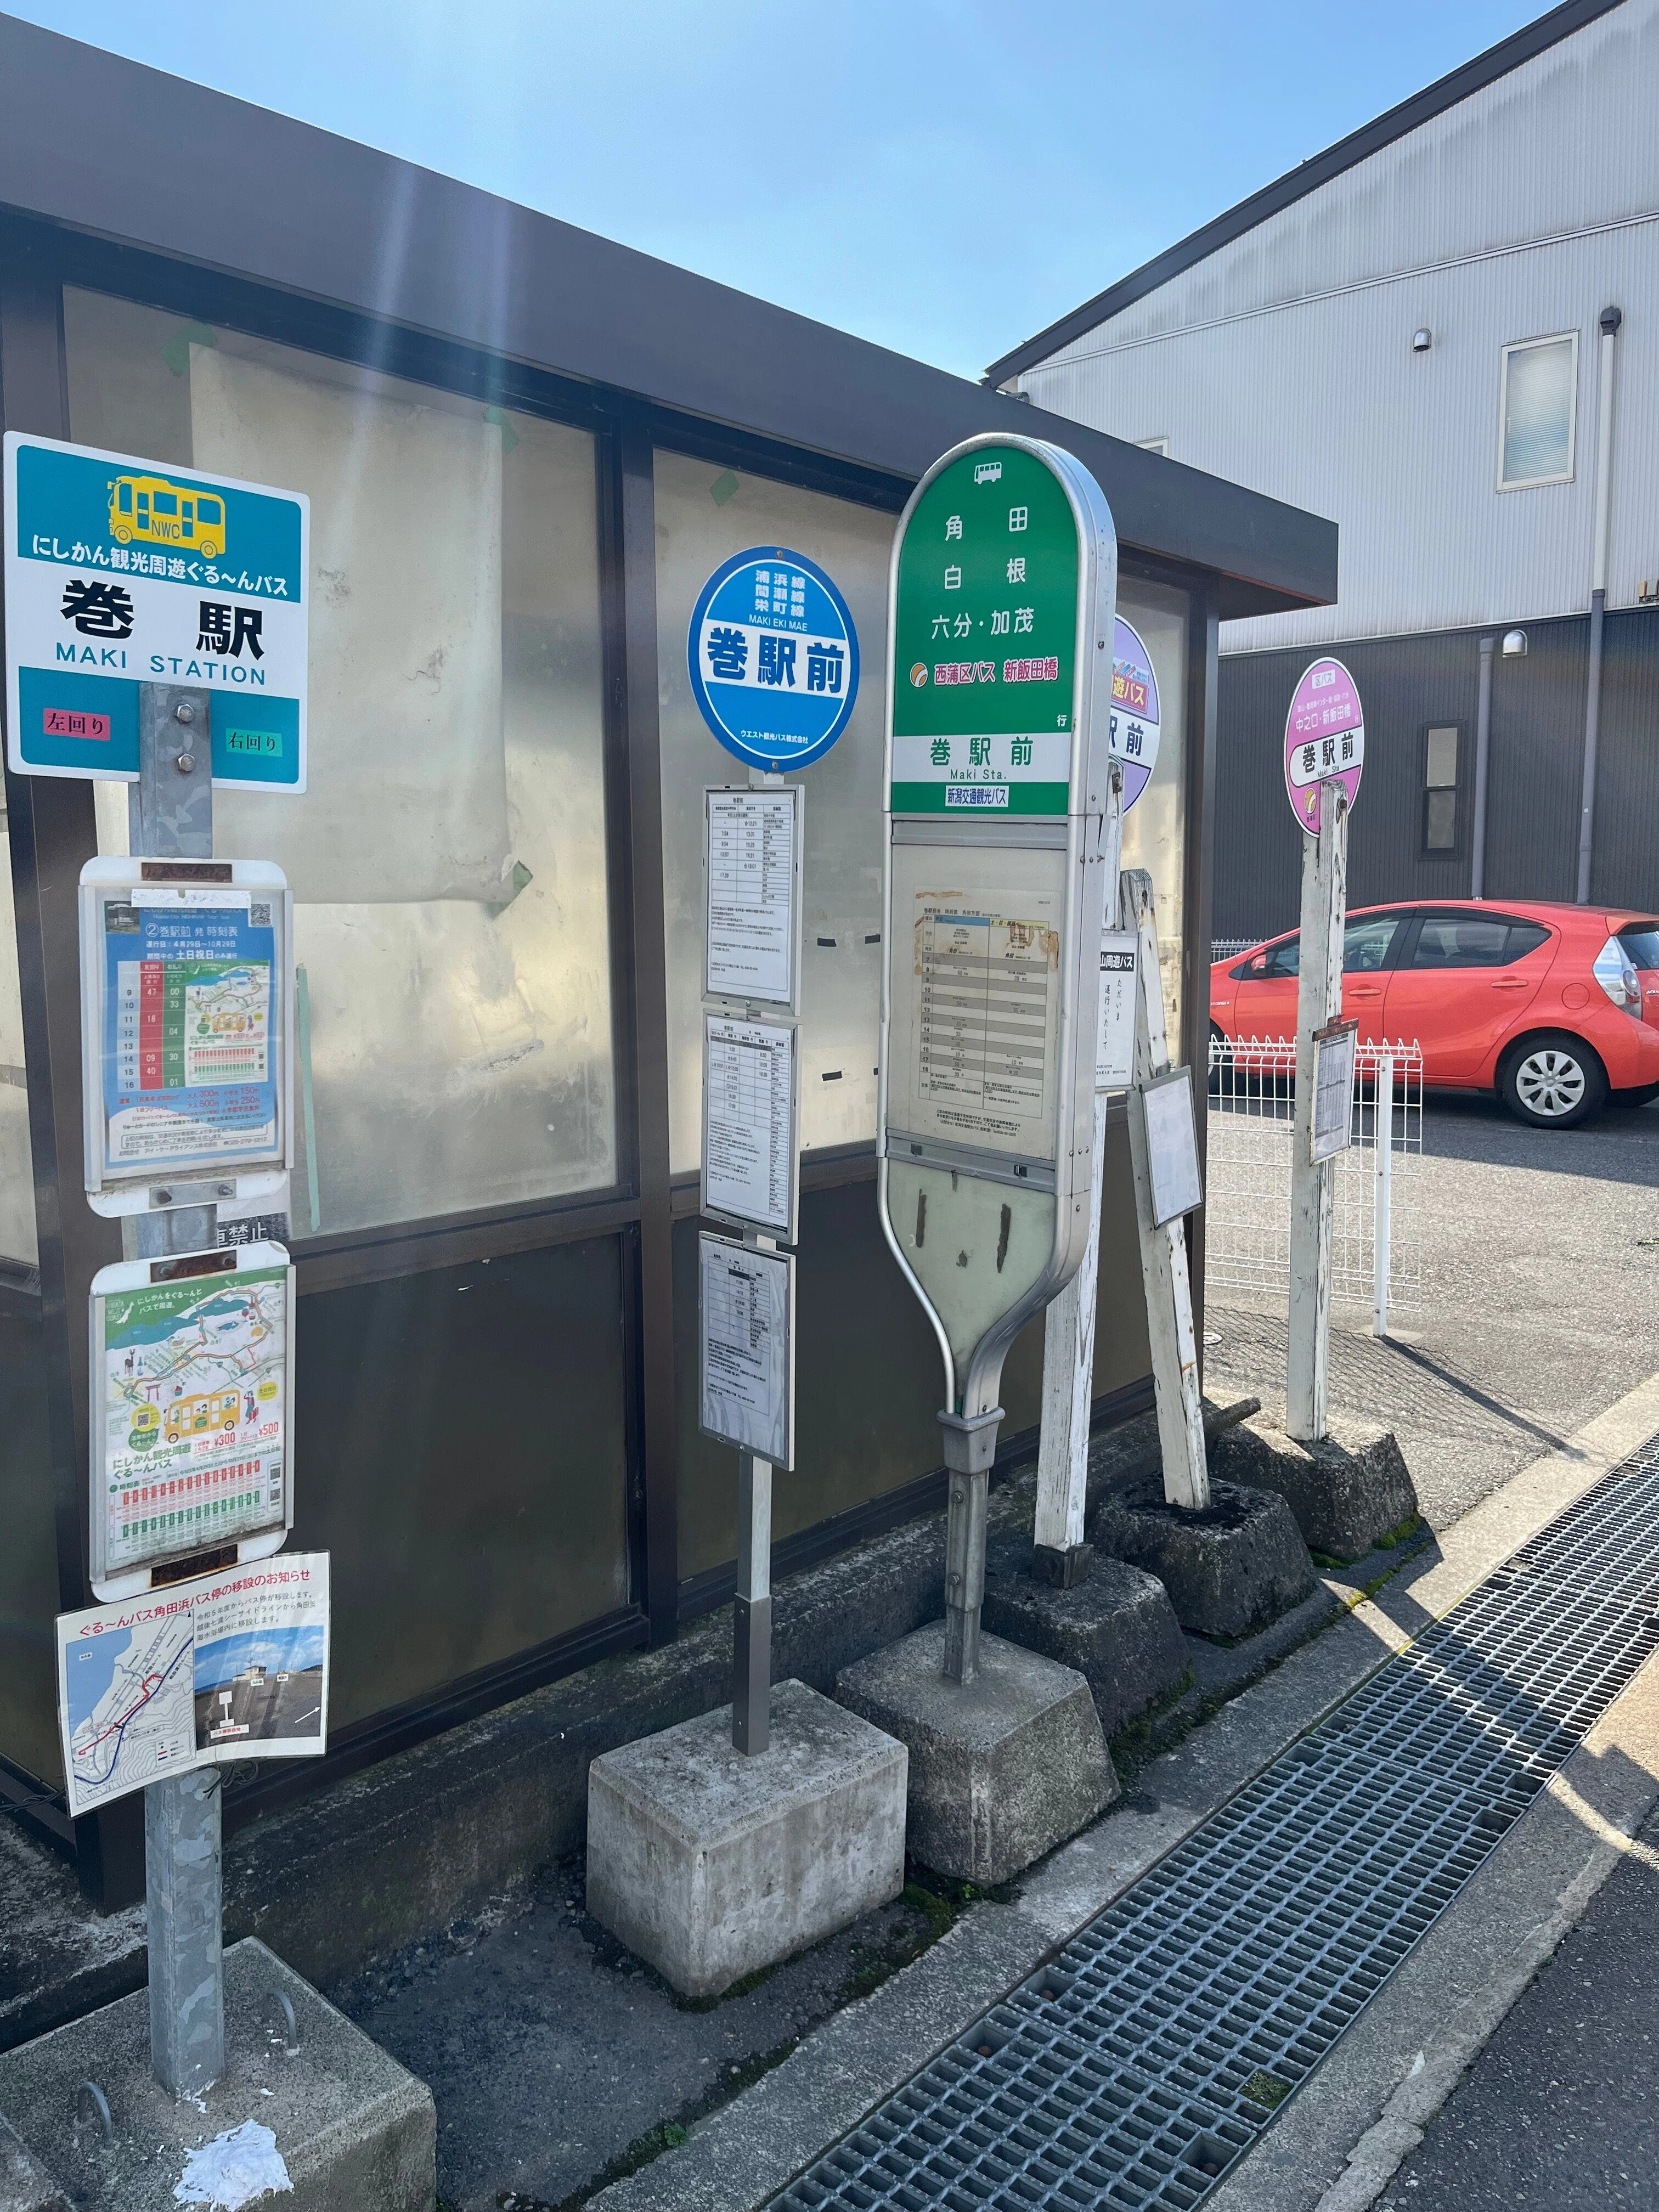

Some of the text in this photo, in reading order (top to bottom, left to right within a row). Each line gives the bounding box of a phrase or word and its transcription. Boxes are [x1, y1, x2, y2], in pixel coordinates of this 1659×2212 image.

[151, 519, 180, 540] NWC
[755, 569, 806, 590] 浦浜線
[754, 599, 805, 618] 栄町線
[749, 614, 808, 631] MAKI EKI MAE
[932, 607, 1035, 640] 六分・加茂
[56, 642, 266, 685] MAKI STATION
[707, 627, 844, 694] 巻駅前
[934, 656, 1059, 686] 西蒲区バス 新飯田橋
[47, 712, 104, 734] 左回り
[1057, 714, 1067, 727] 行
[228, 731, 276, 753] 右回り
[930, 736, 1034, 767] 巻駅前
[1302, 731, 1354, 774] 巻駅前
[950, 769, 1007, 780] Maki Sta.
[1317, 769, 1328, 778] Maki
[947, 787, 1006, 805] 新潟交通観光バス
[207, 926, 238, 937] 時刻表
